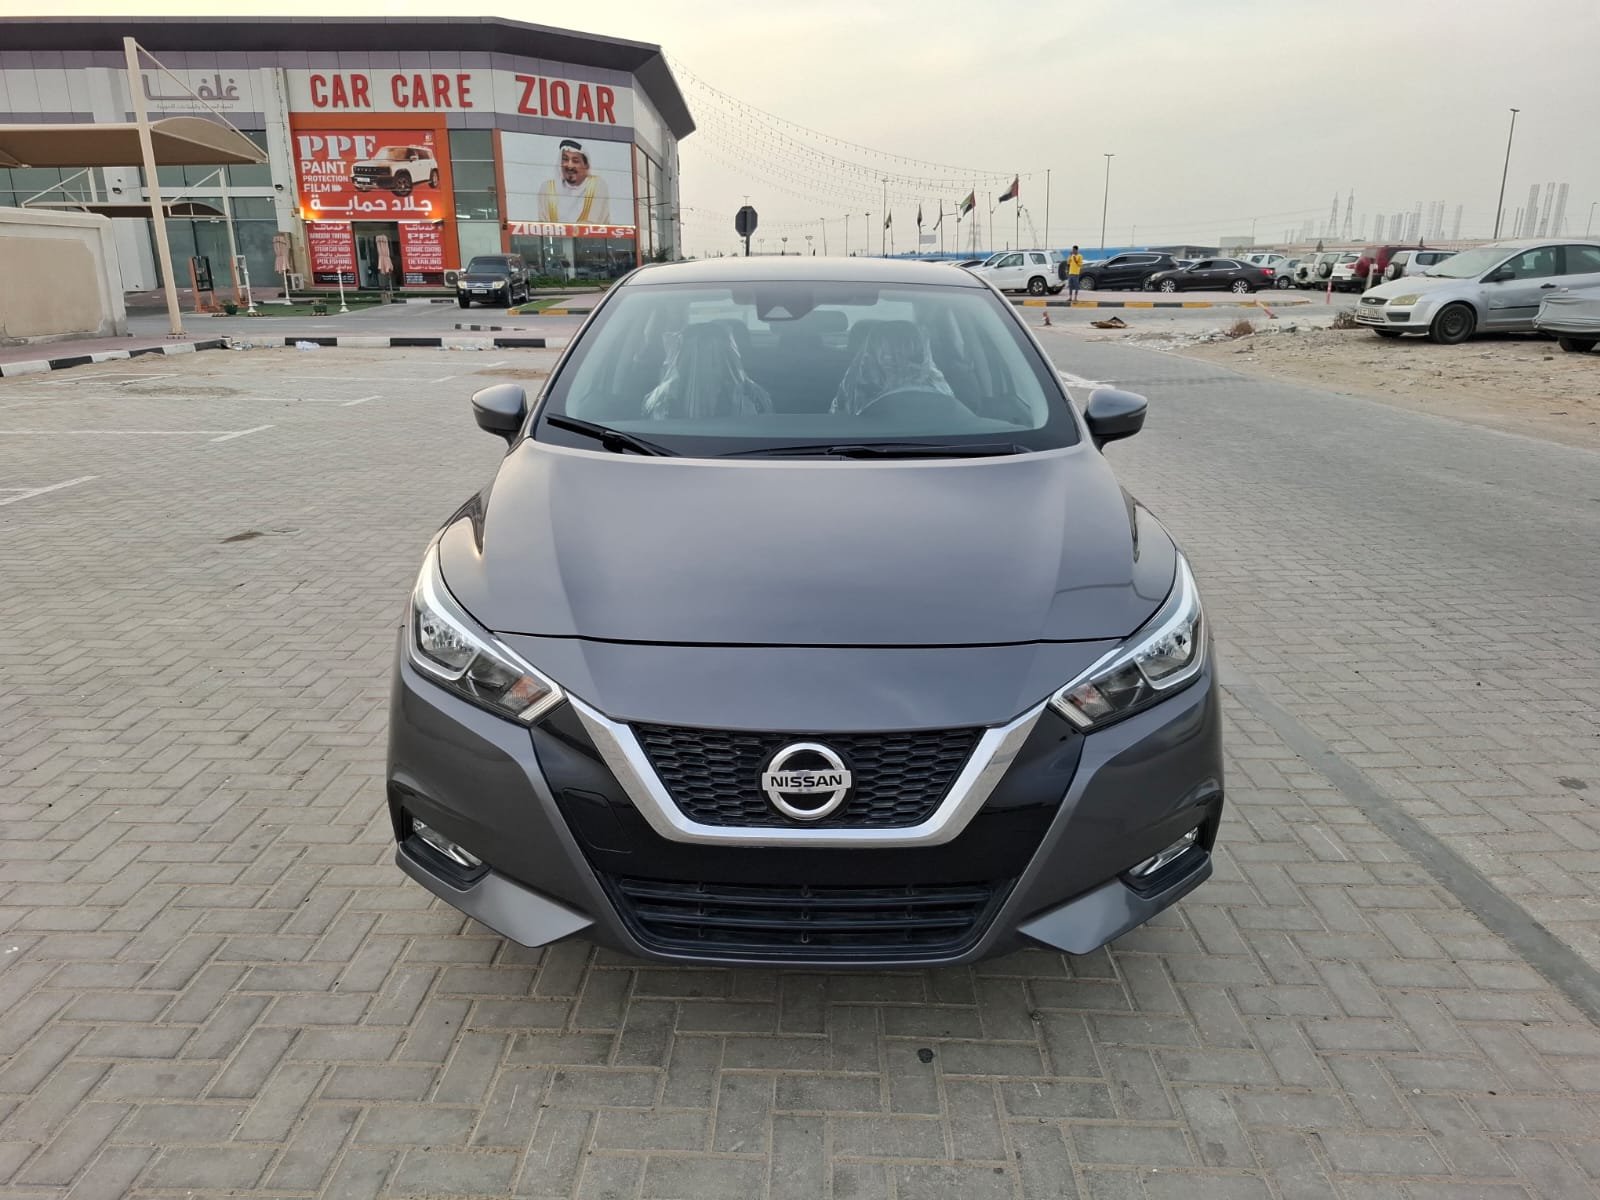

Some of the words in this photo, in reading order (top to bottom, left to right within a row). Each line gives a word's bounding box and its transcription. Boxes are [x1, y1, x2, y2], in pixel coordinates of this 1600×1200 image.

[310, 73, 371, 108] CAR
[391, 73, 473, 108] CARE
[515, 74, 616, 124] ZIQAR
[297, 135, 376, 160] PPF
[301, 161, 347, 174] PAINT
[302, 175, 349, 183] PROTECTION
[303, 183, 331, 193] FILM
[310, 193, 387, 216] حماية
[391, 195, 433, 217] جلاد
[511, 223, 567, 236] ZIQAR
[770, 774, 843, 788] NISSAN
